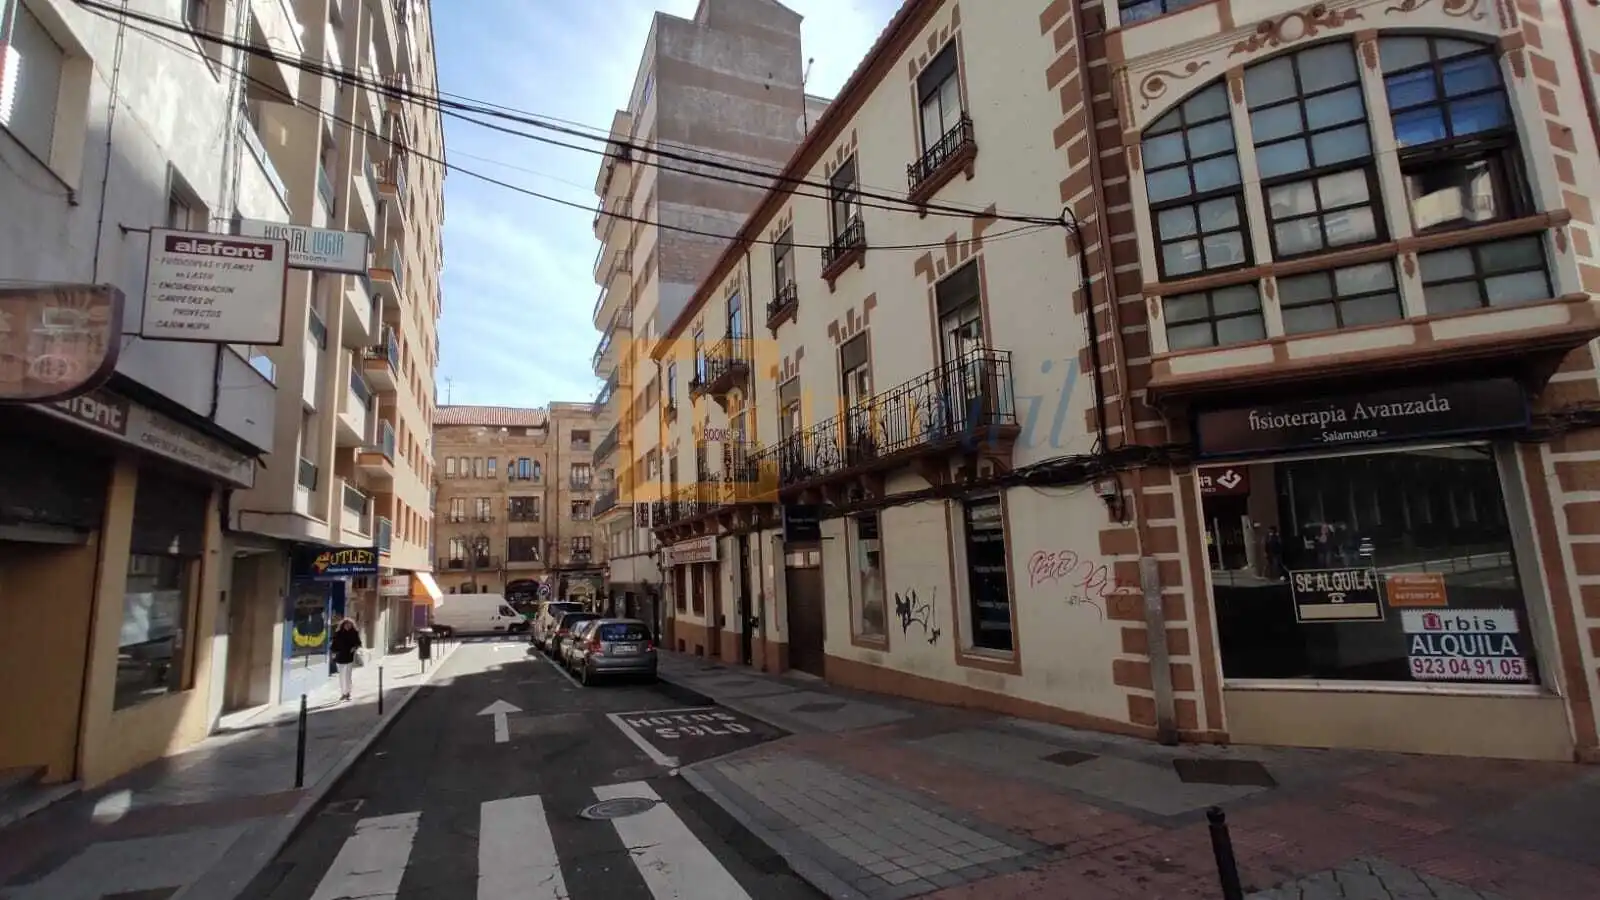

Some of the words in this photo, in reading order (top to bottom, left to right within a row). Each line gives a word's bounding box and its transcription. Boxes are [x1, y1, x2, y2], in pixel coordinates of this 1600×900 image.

[175, 240, 265, 259] alafont
[1249, 404, 1347, 430] fisioterapia
[1353, 393, 1450, 420] Avanzada
[1322, 429, 1378, 443] Salamanca
[1296, 573, 1314, 592] SE
[1316, 570, 1374, 592] ALQUILA
[1411, 634, 1519, 656] ALQUILA
[1414, 658, 1446, 674] 923
[1449, 658, 1472, 675] 04
[1475, 659, 1496, 675] 91
[1500, 659, 1523, 675] 05
[627, 712, 736, 728] MOTOS
